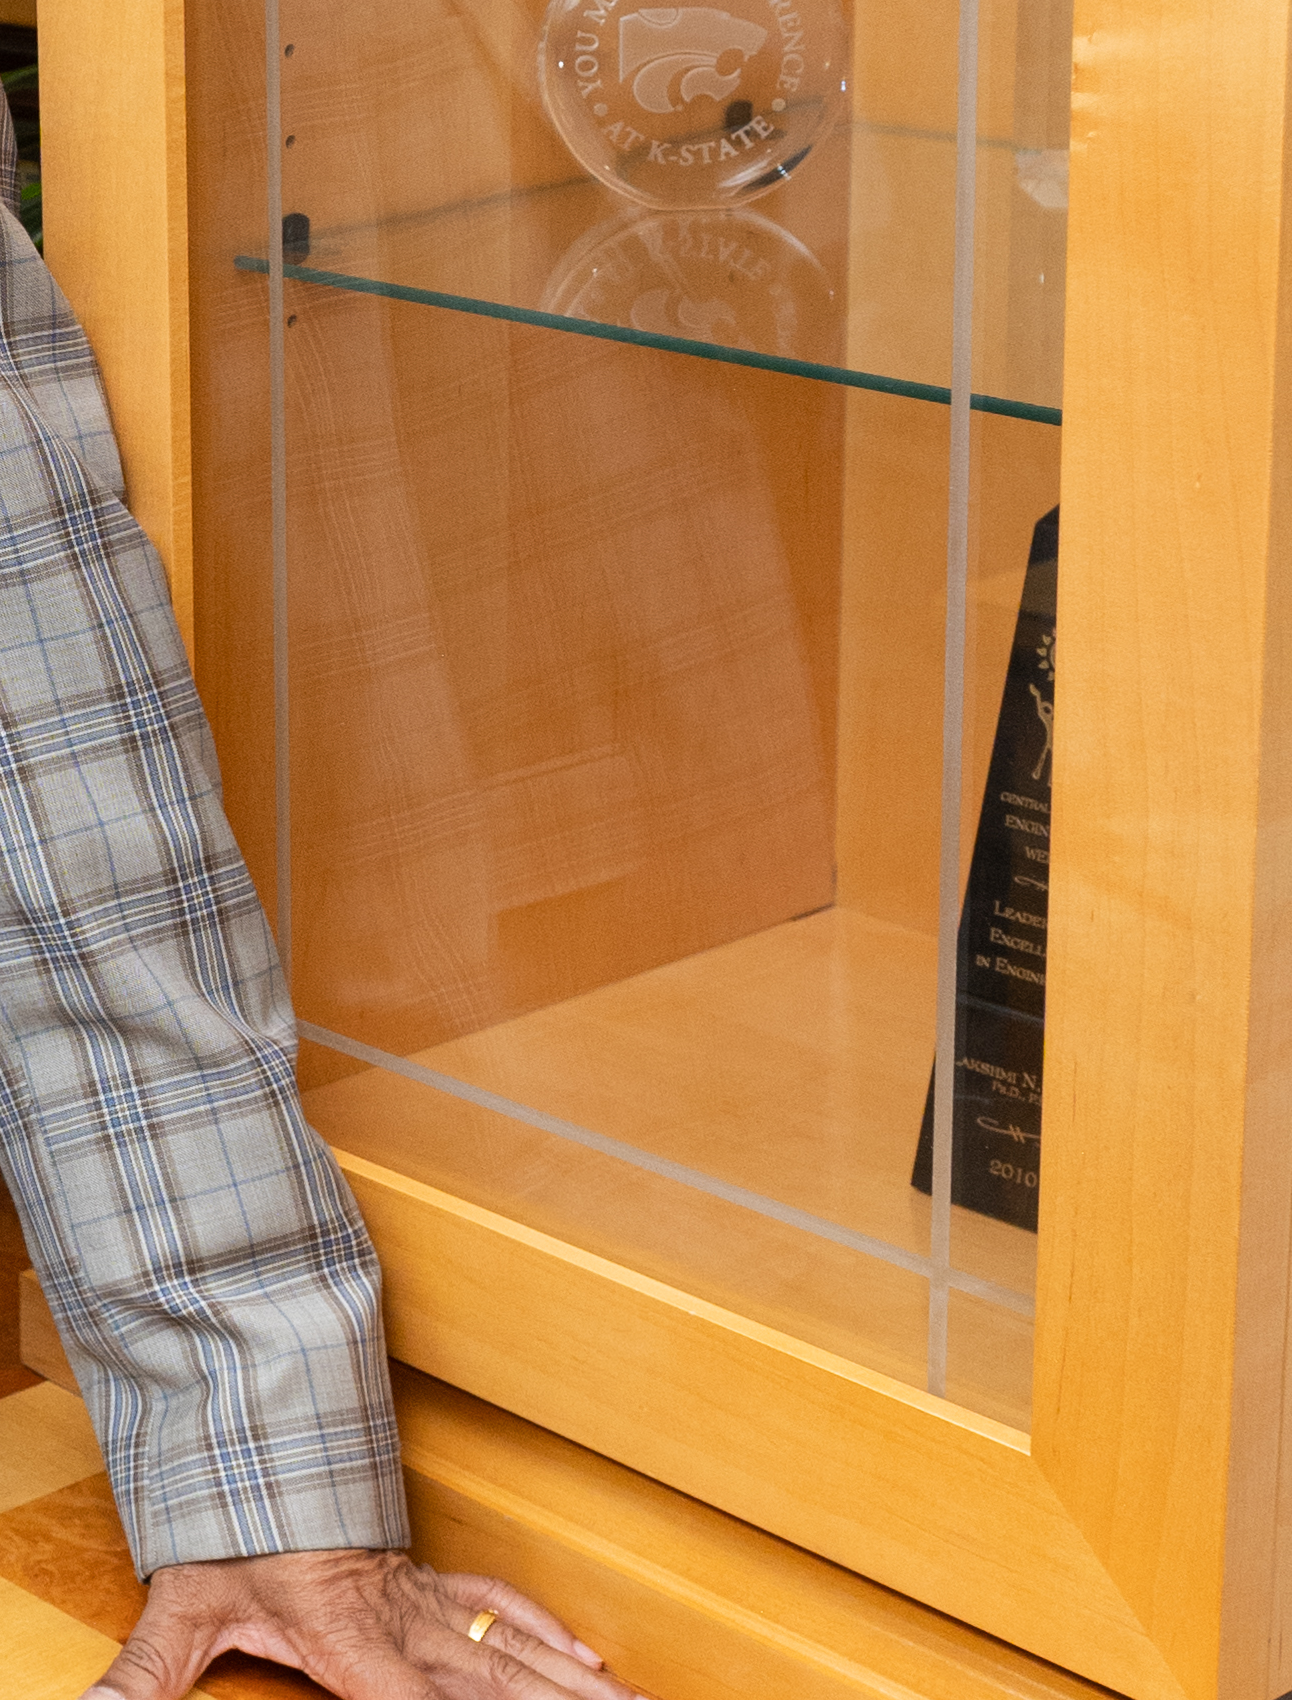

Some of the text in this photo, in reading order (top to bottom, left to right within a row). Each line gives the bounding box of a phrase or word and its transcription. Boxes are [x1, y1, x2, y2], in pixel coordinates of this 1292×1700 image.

[575, 30, 605, 99] YOU
[601, 115, 775, 166] AT K-STATE
[989, 1159, 1037, 1188] 2010
